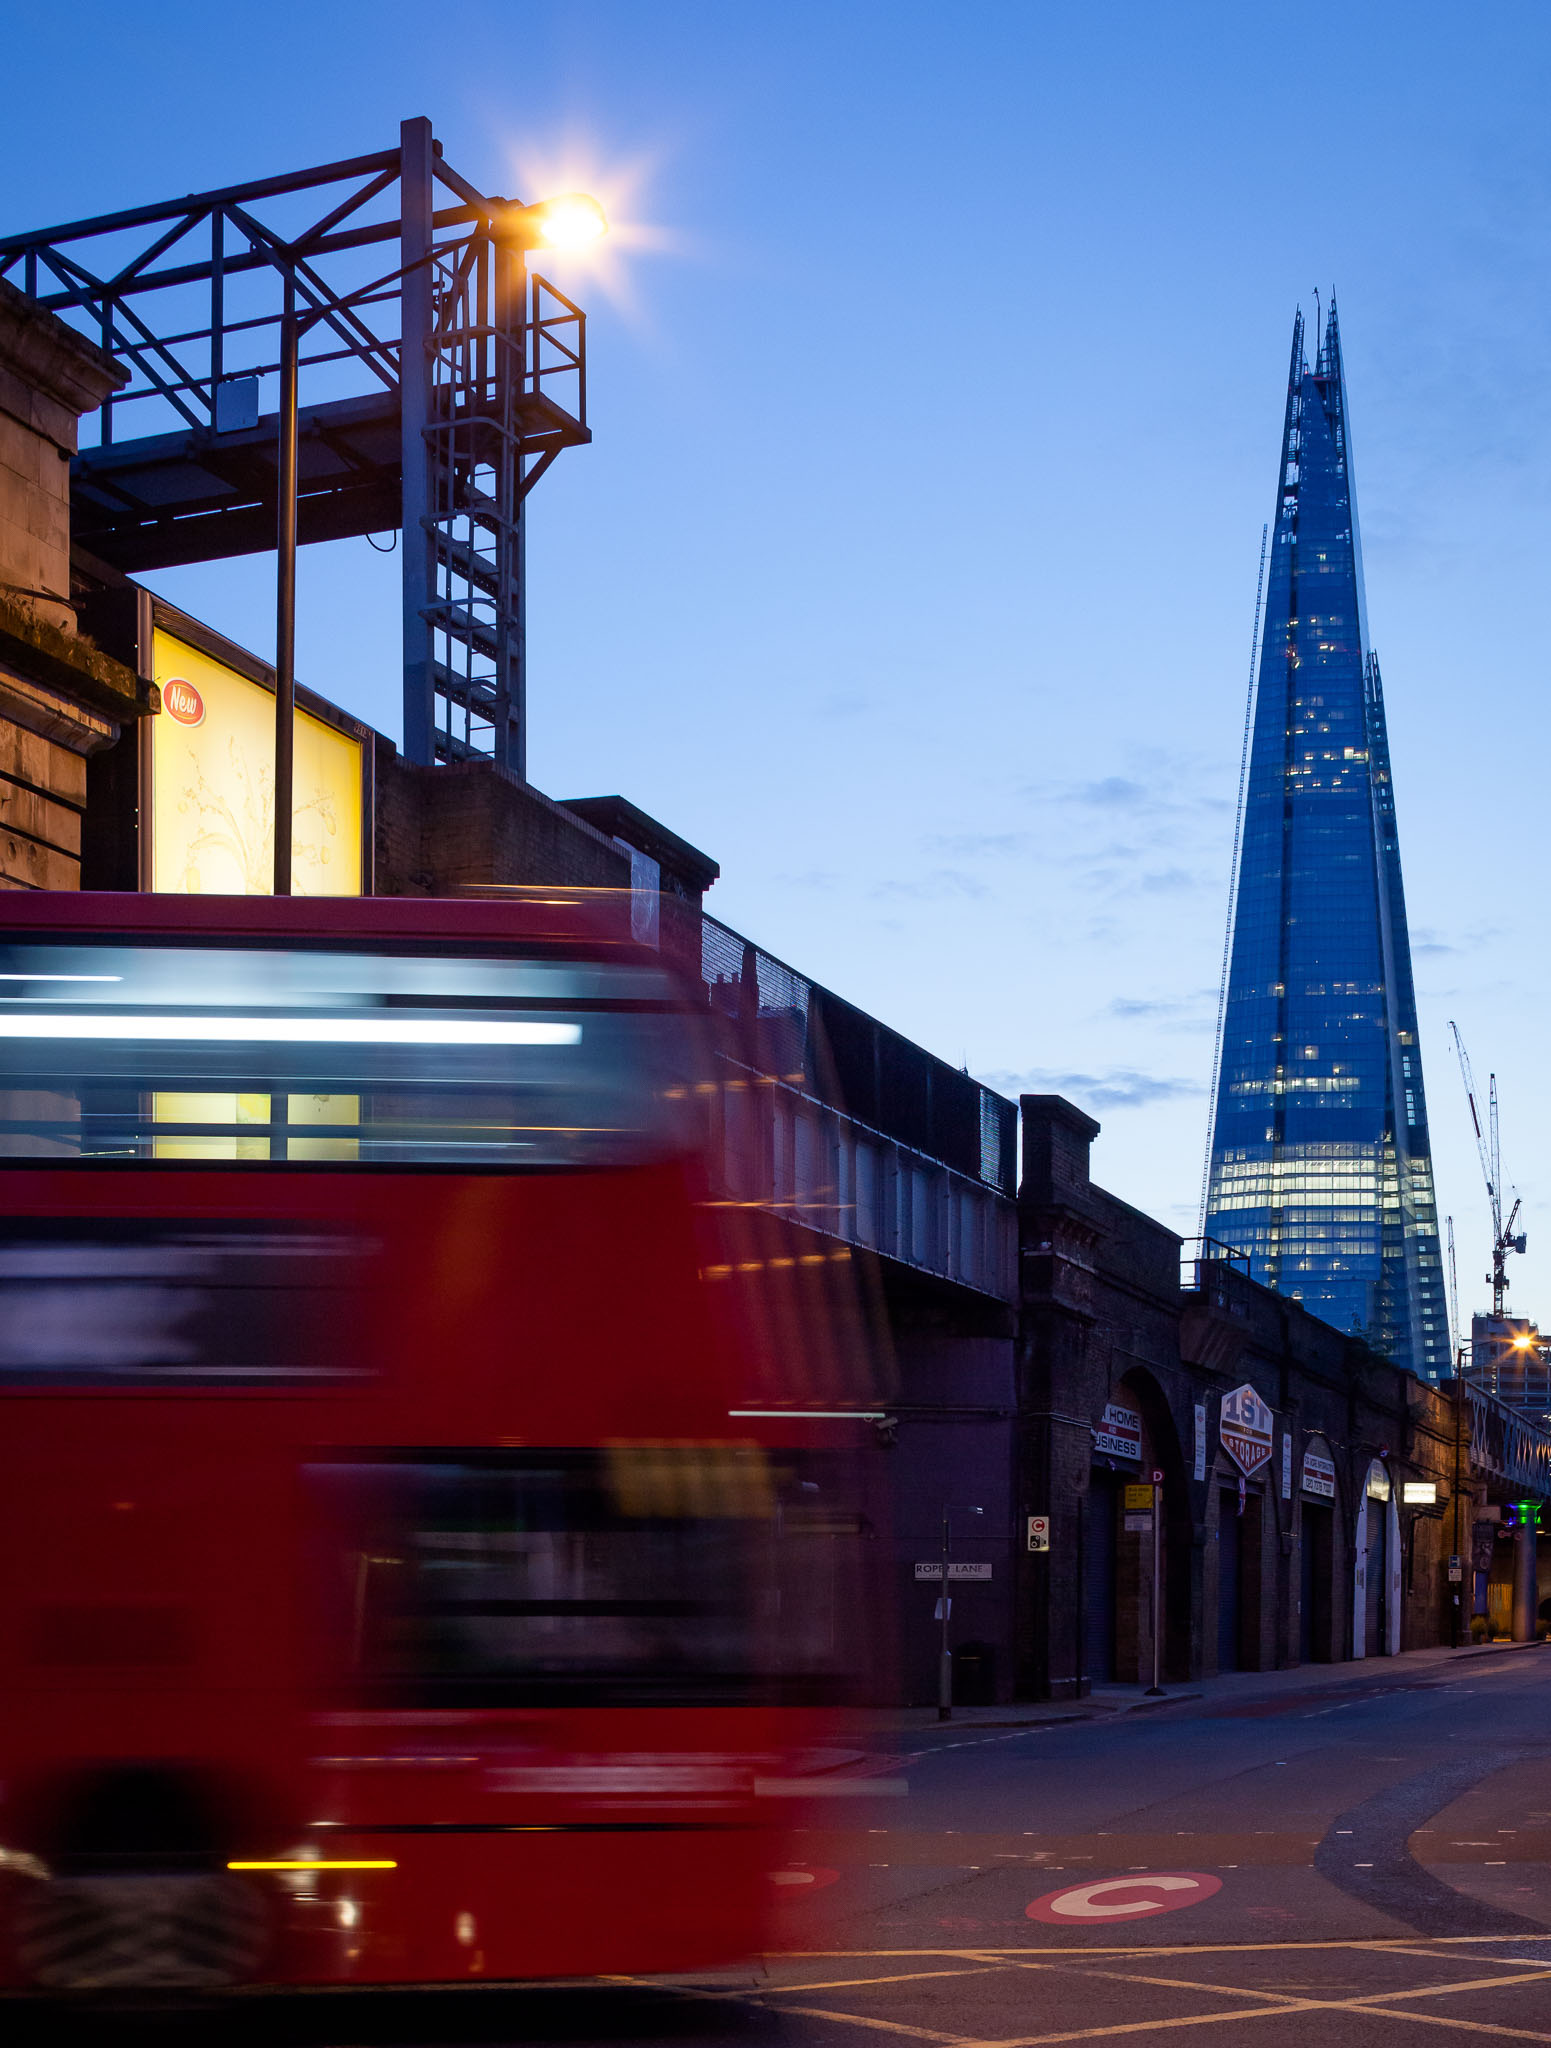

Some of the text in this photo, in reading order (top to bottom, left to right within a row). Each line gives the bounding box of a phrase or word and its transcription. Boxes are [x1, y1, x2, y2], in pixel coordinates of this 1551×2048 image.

[170, 686, 197, 714] New
[1110, 1408, 1139, 1430] HOME
[1096, 1434, 1137, 1456] USINESS
[1228, 1438, 1266, 1467] STORAGE
[1153, 1471, 1163, 1482] D
[955, 1565, 983, 1573] LANE
[1049, 1876, 1200, 1918] C
